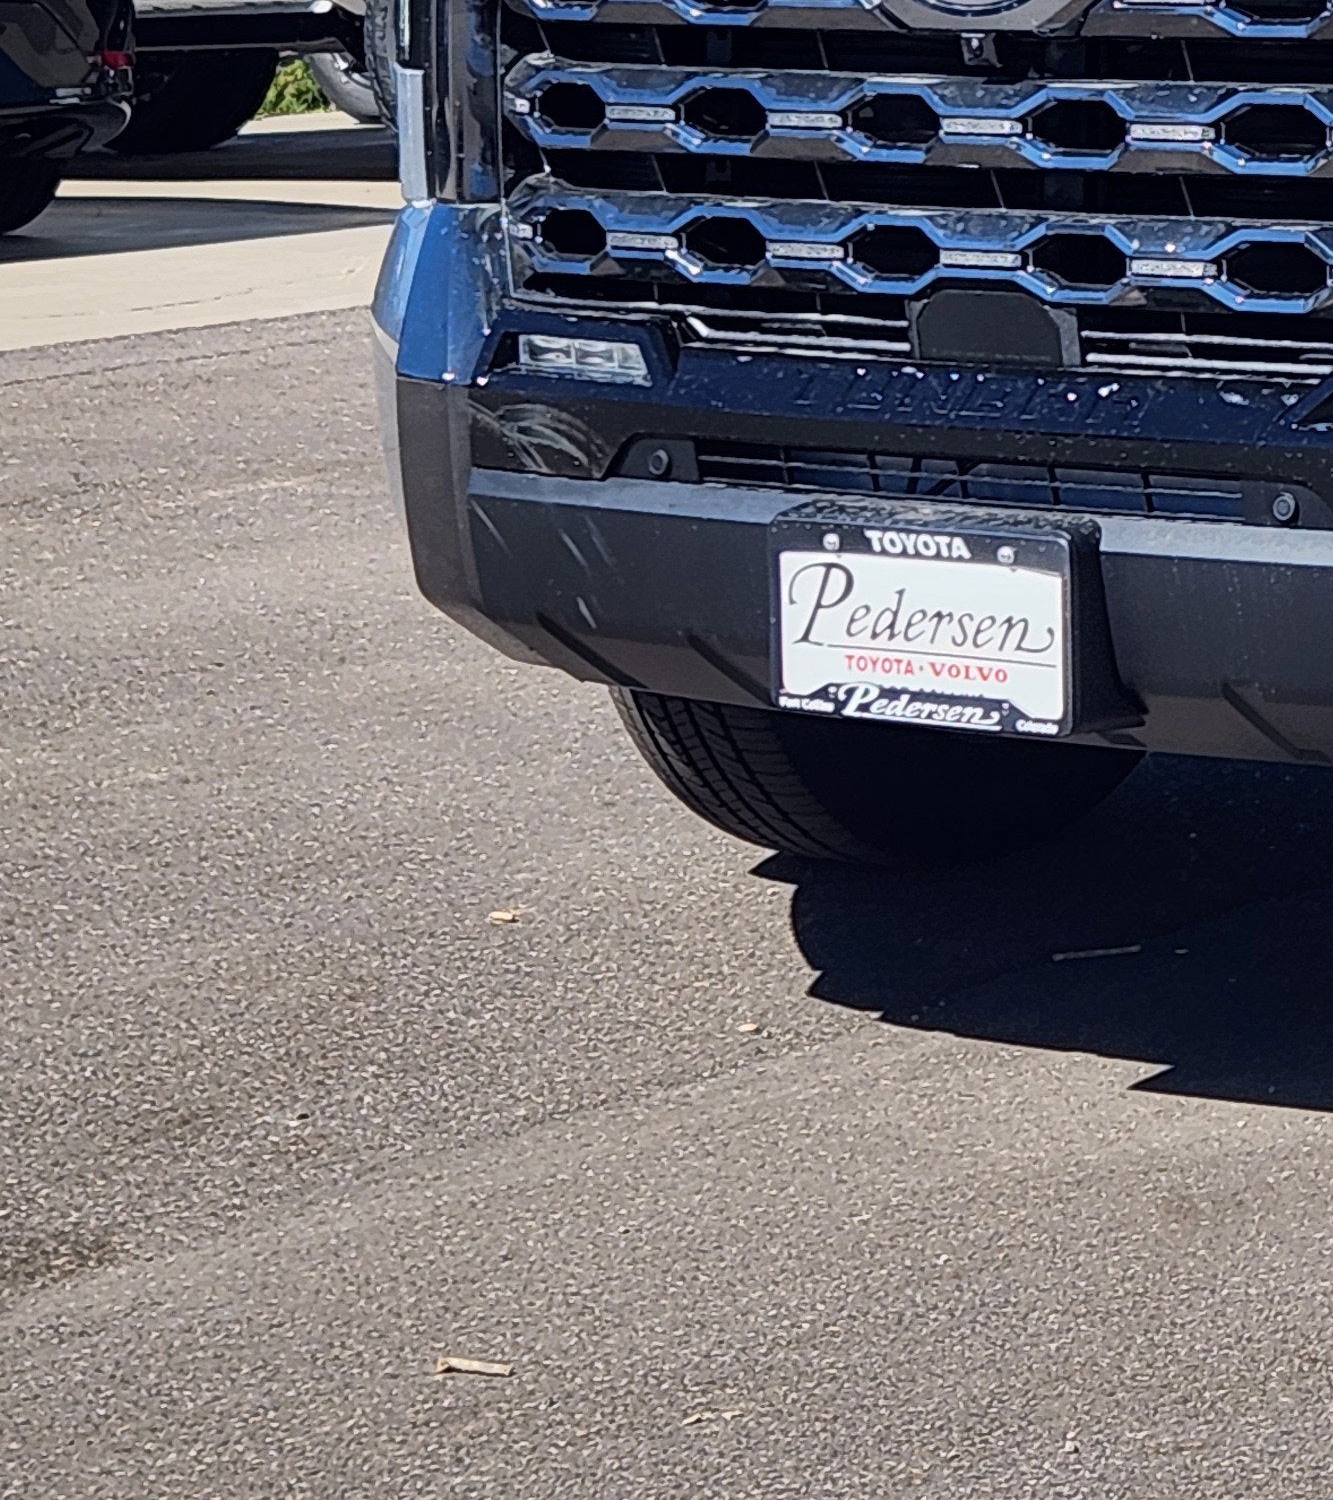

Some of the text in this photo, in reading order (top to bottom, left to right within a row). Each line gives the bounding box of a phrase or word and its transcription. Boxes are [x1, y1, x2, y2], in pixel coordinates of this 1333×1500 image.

[863, 529, 972, 560] TOYOTA
[788, 562, 1056, 654] Pedersen
[845, 654, 1009, 684] TOYOTA VOLVO
[837, 682, 1002, 728] Pedersen
